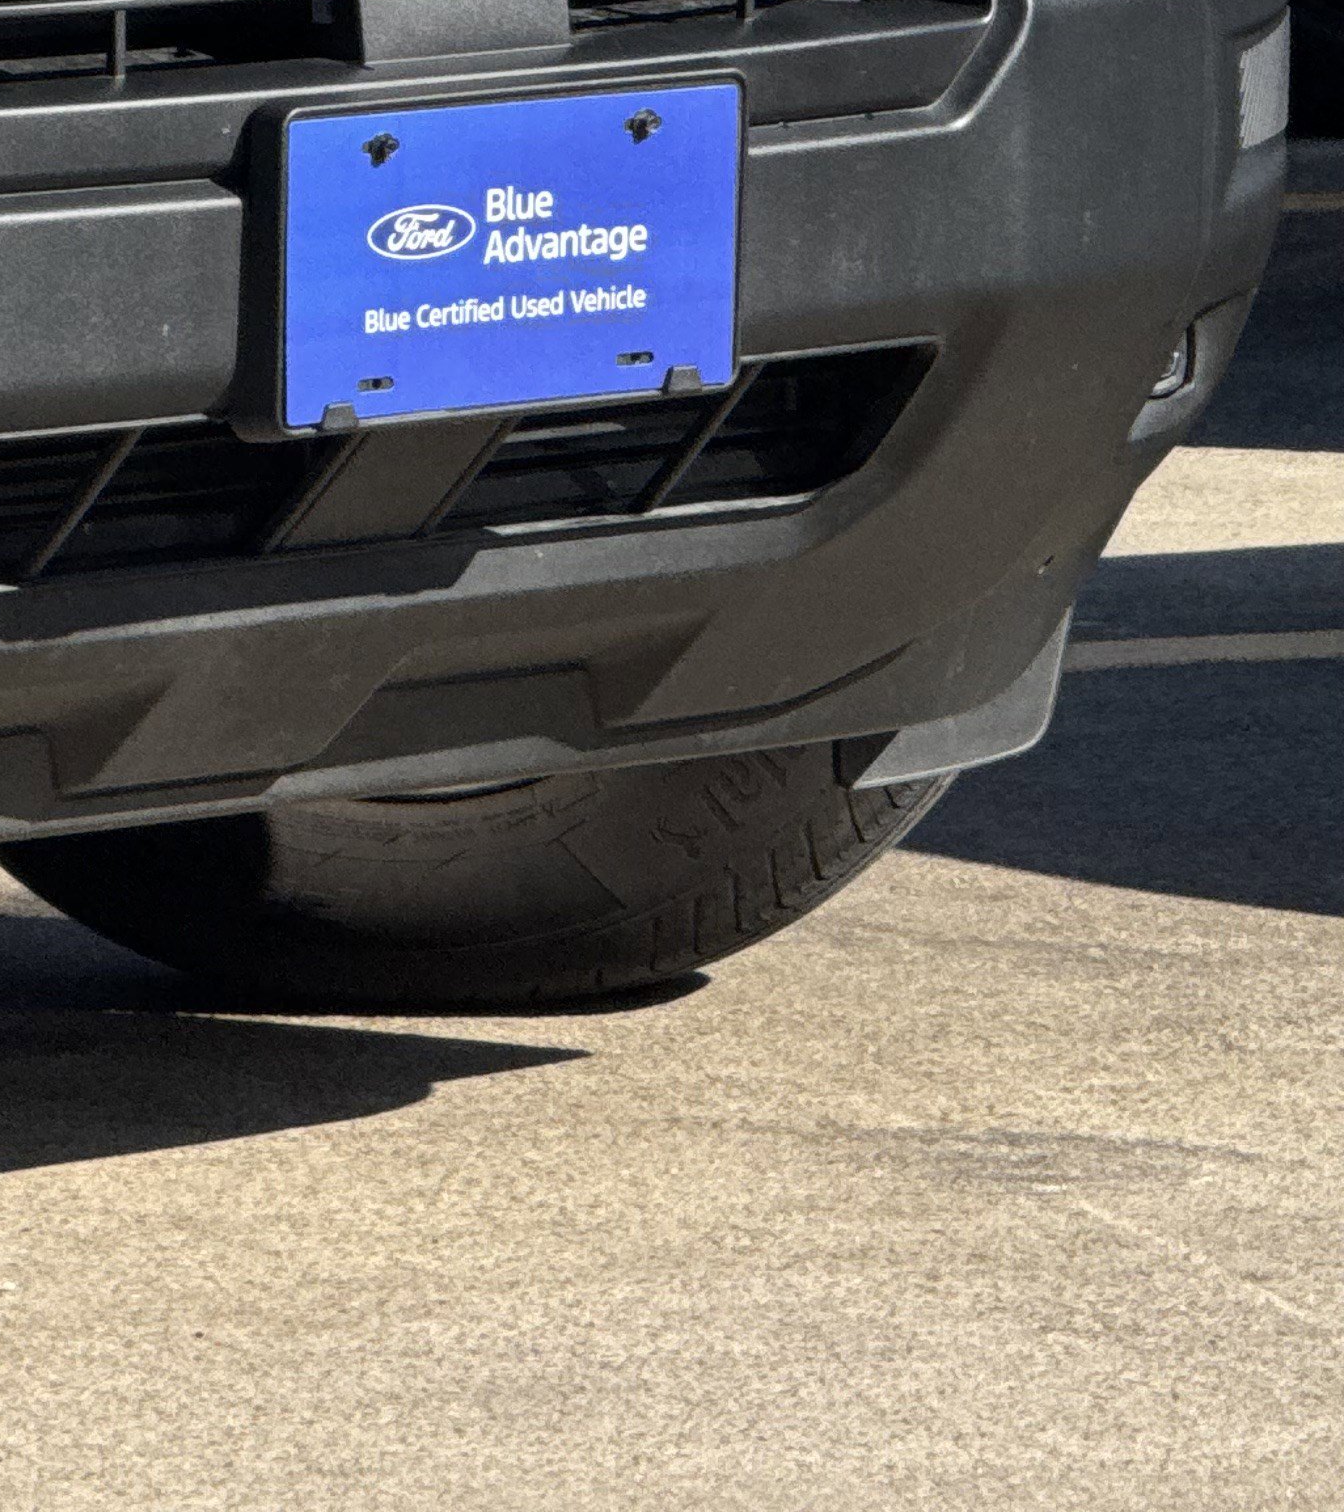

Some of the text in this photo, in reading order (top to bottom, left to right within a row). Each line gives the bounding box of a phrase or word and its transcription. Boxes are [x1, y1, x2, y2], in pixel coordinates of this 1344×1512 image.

[485, 186, 554, 223] Blue
[387, 212, 455, 253] Ford
[483, 223, 648, 265] Advantage
[364, 284, 647, 334] Blue Certified Used Vehicle
